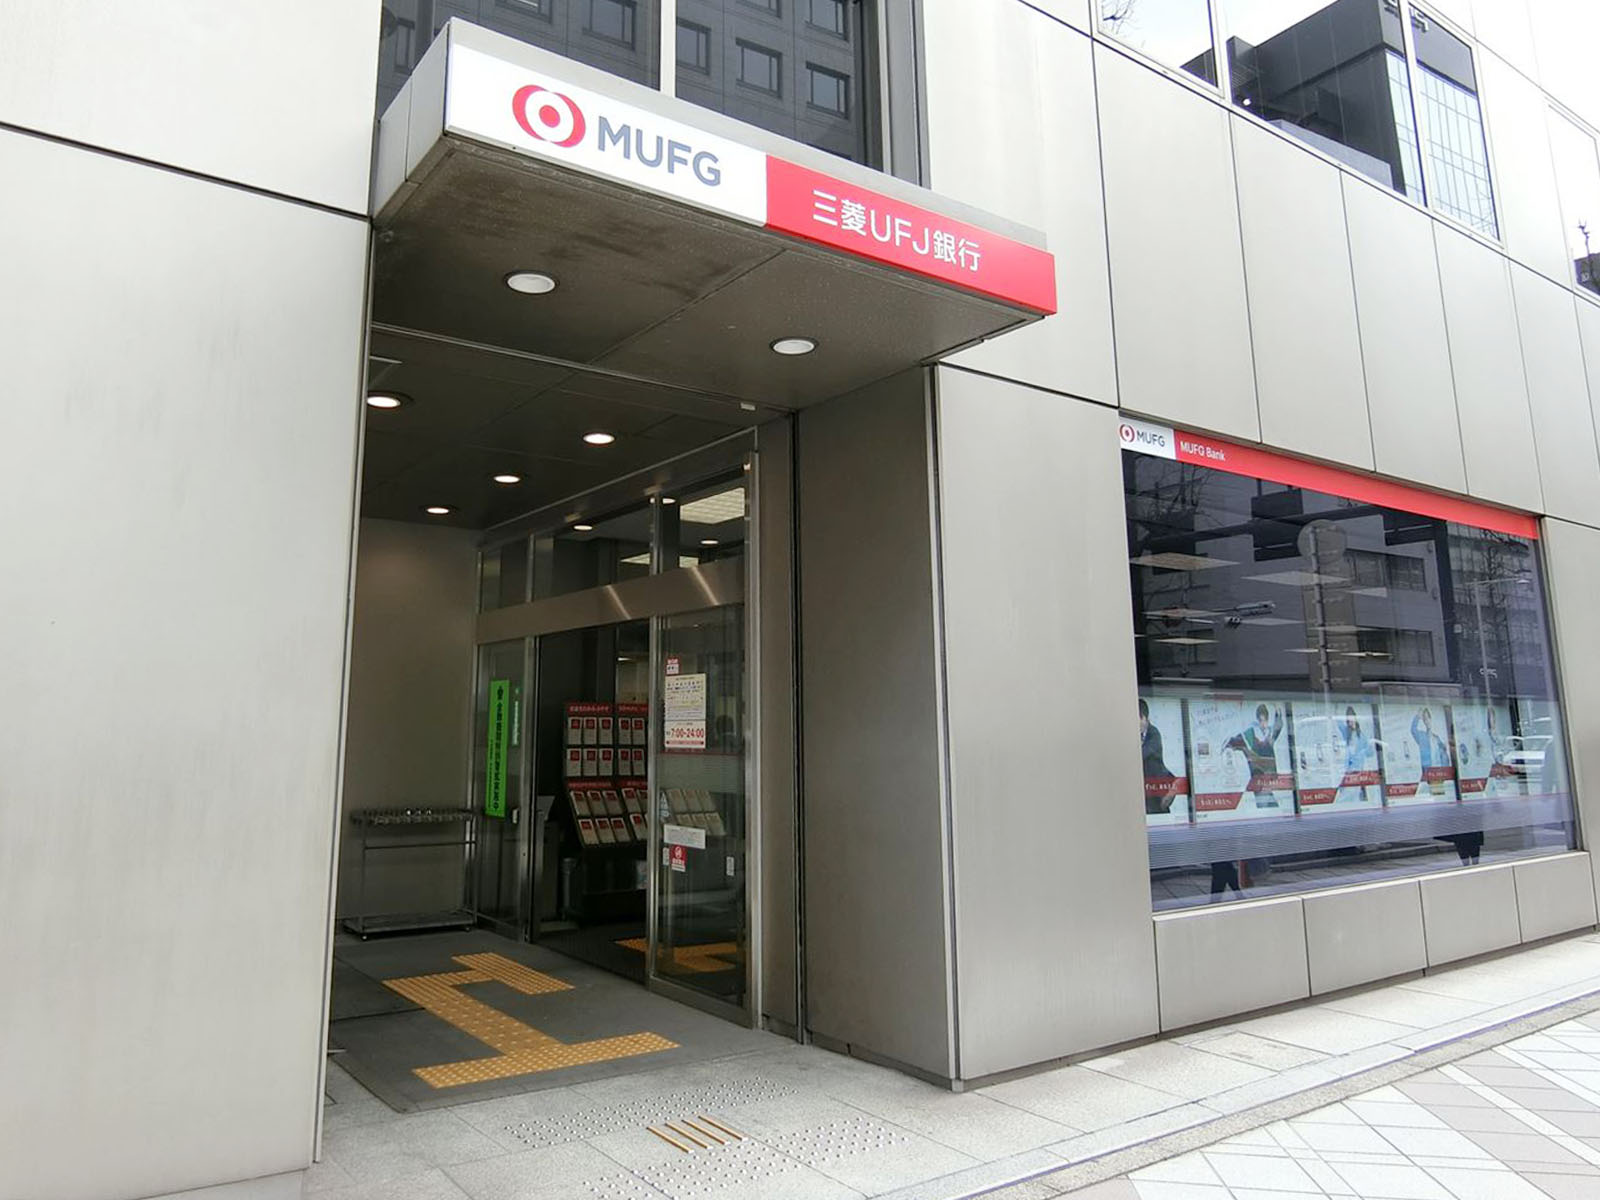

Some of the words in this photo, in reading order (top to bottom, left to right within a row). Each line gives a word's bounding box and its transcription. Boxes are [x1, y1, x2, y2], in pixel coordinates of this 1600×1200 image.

[598, 115, 722, 188] MUFG
[812, 188, 982, 273] 三菱UFJ銀行
[1136, 430, 1166, 448] MUFG
[1180, 441, 1205, 457] MUFG
[1206, 446, 1226, 462] Bank
